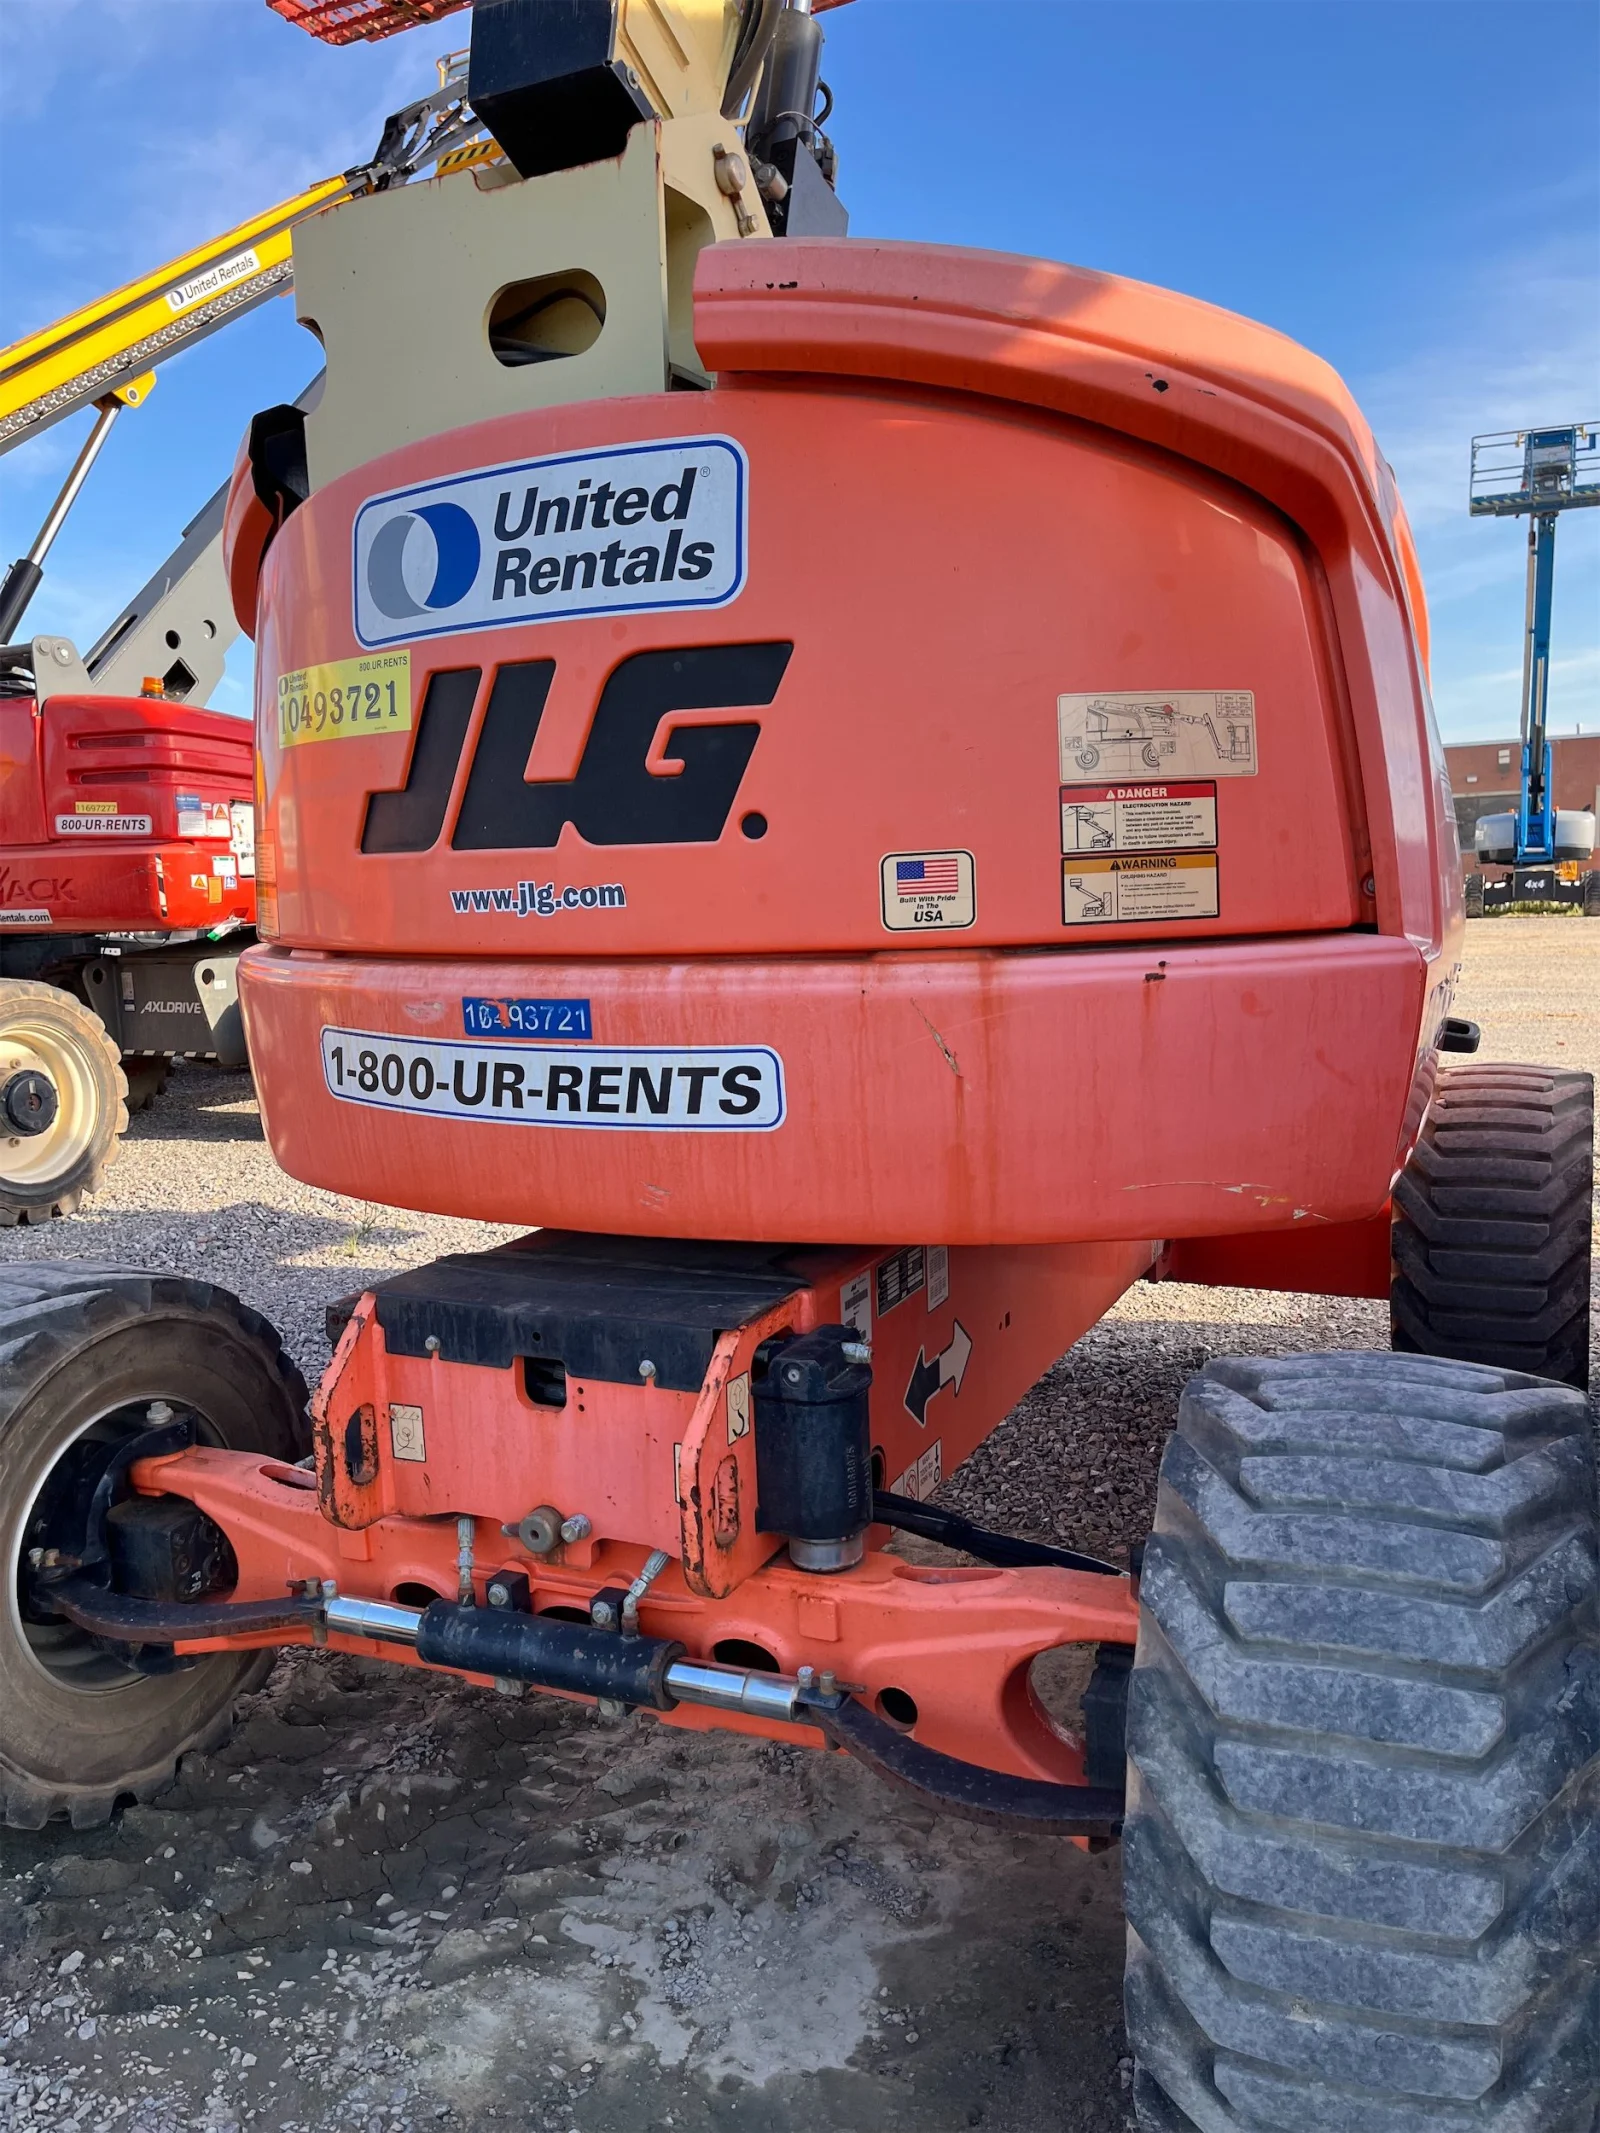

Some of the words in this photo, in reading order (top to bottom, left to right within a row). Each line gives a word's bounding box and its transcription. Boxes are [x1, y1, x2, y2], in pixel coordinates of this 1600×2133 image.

[184, 272, 218, 299] United
[218, 256, 254, 282] Rentals
[493, 467, 697, 542] United
[492, 529, 715, 600] Rentals
[280, 680, 398, 735] 10493721
[1117, 787, 1168, 799] DANGER
[61, 819, 146, 831] 800-UR-RENTS
[1121, 857, 1177, 869] WARNING
[1524, 879, 1546, 889] 4x4
[451, 882, 626, 916] www.jlg.com
[936, 894, 956, 902] Pride
[926, 902, 940, 910] The
[0, 912, 50, 922] entals.com
[914, 910, 944, 922] USA
[140, 1001, 201, 1014] AXLDRIVE
[465, 1004, 586, 1031] 1093721
[330, 1046, 762, 1116] 1-800-UR-RENTS
